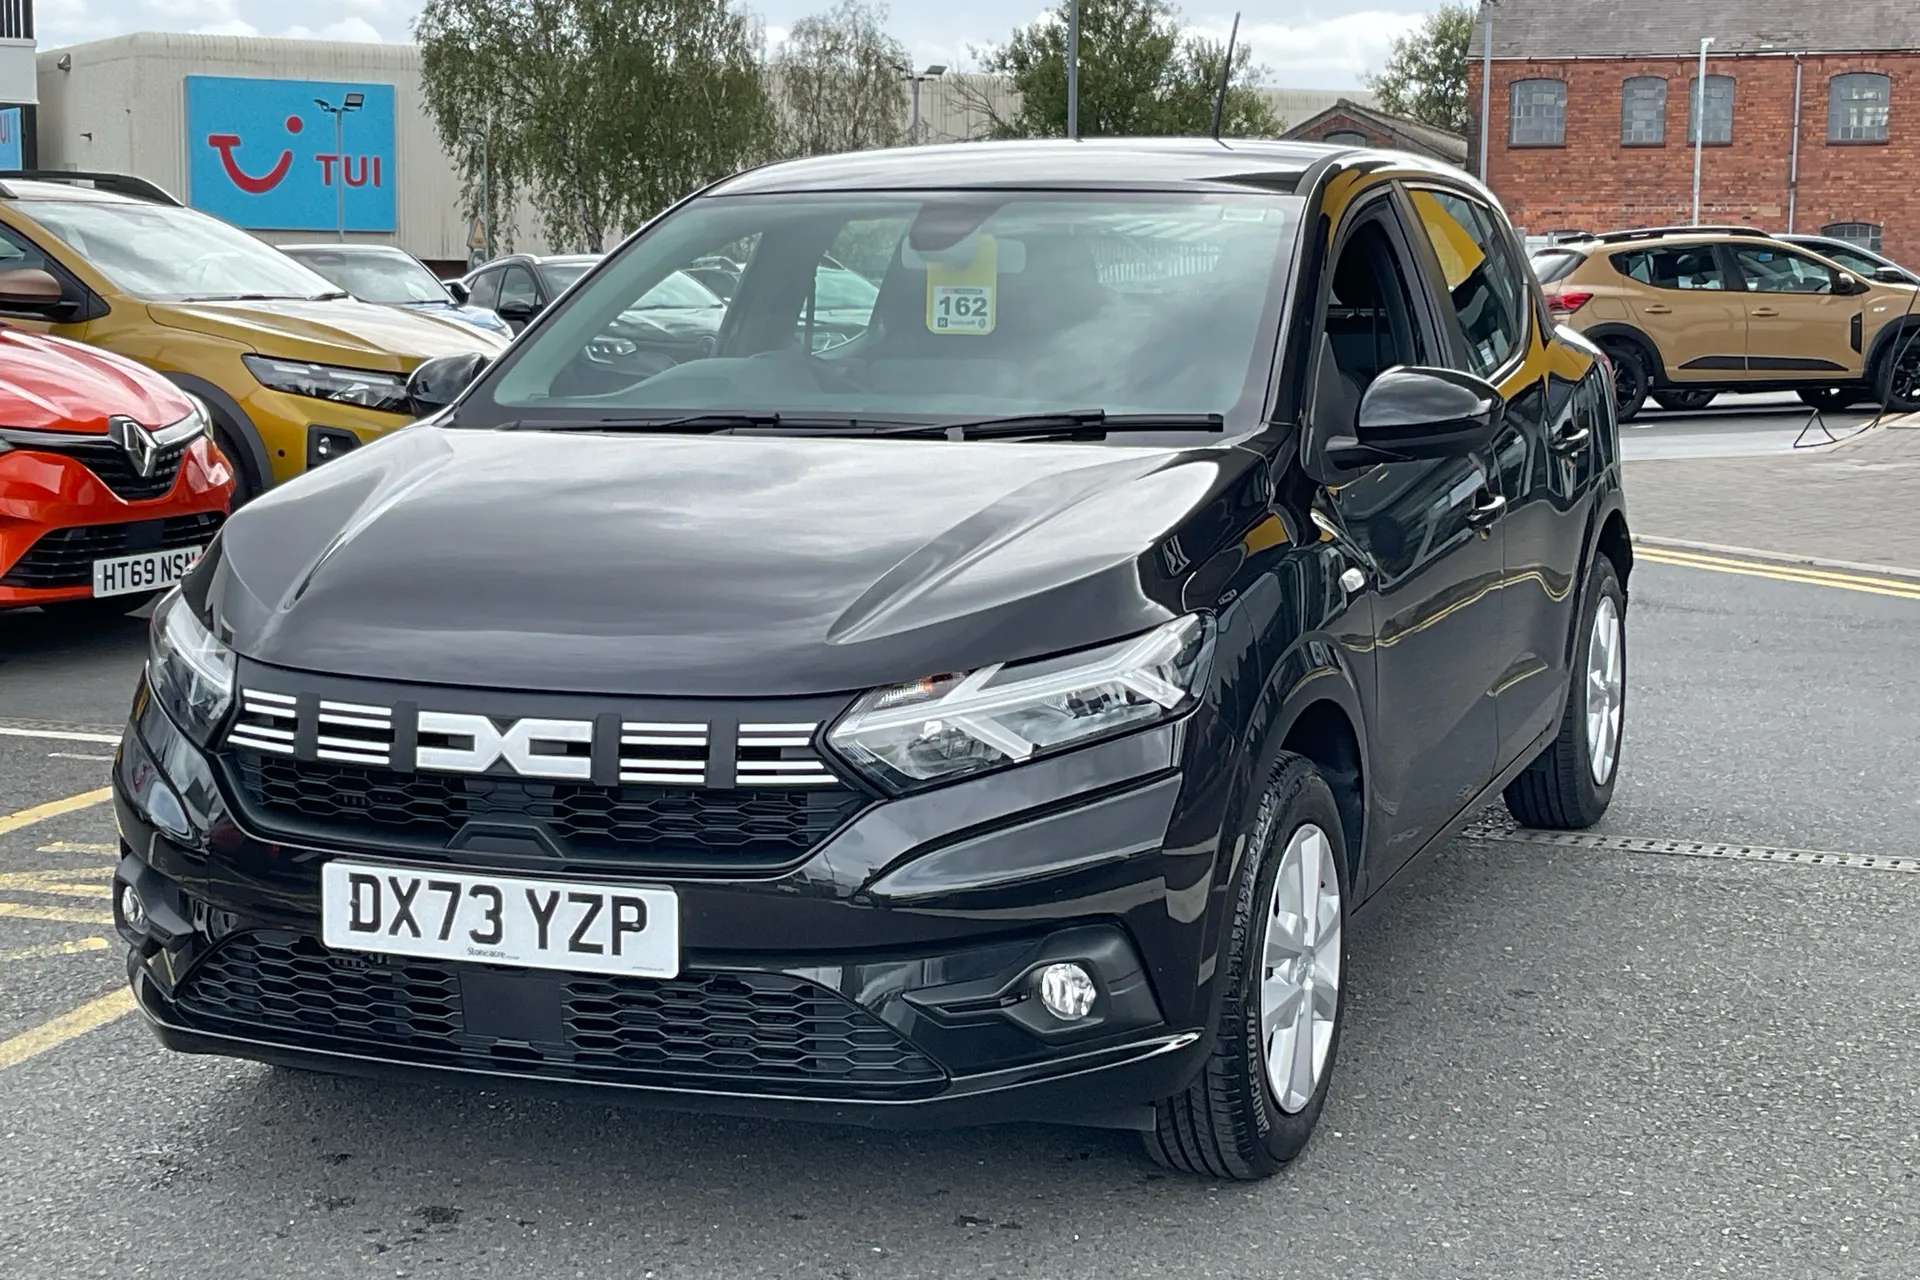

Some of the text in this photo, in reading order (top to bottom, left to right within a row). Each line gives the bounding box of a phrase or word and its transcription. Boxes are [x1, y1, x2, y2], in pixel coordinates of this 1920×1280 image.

[315, 155, 381, 188] TUI
[939, 296, 987, 316] 162
[103, 558, 155, 591] HT69
[349, 872, 648, 956] DX73 YZP
